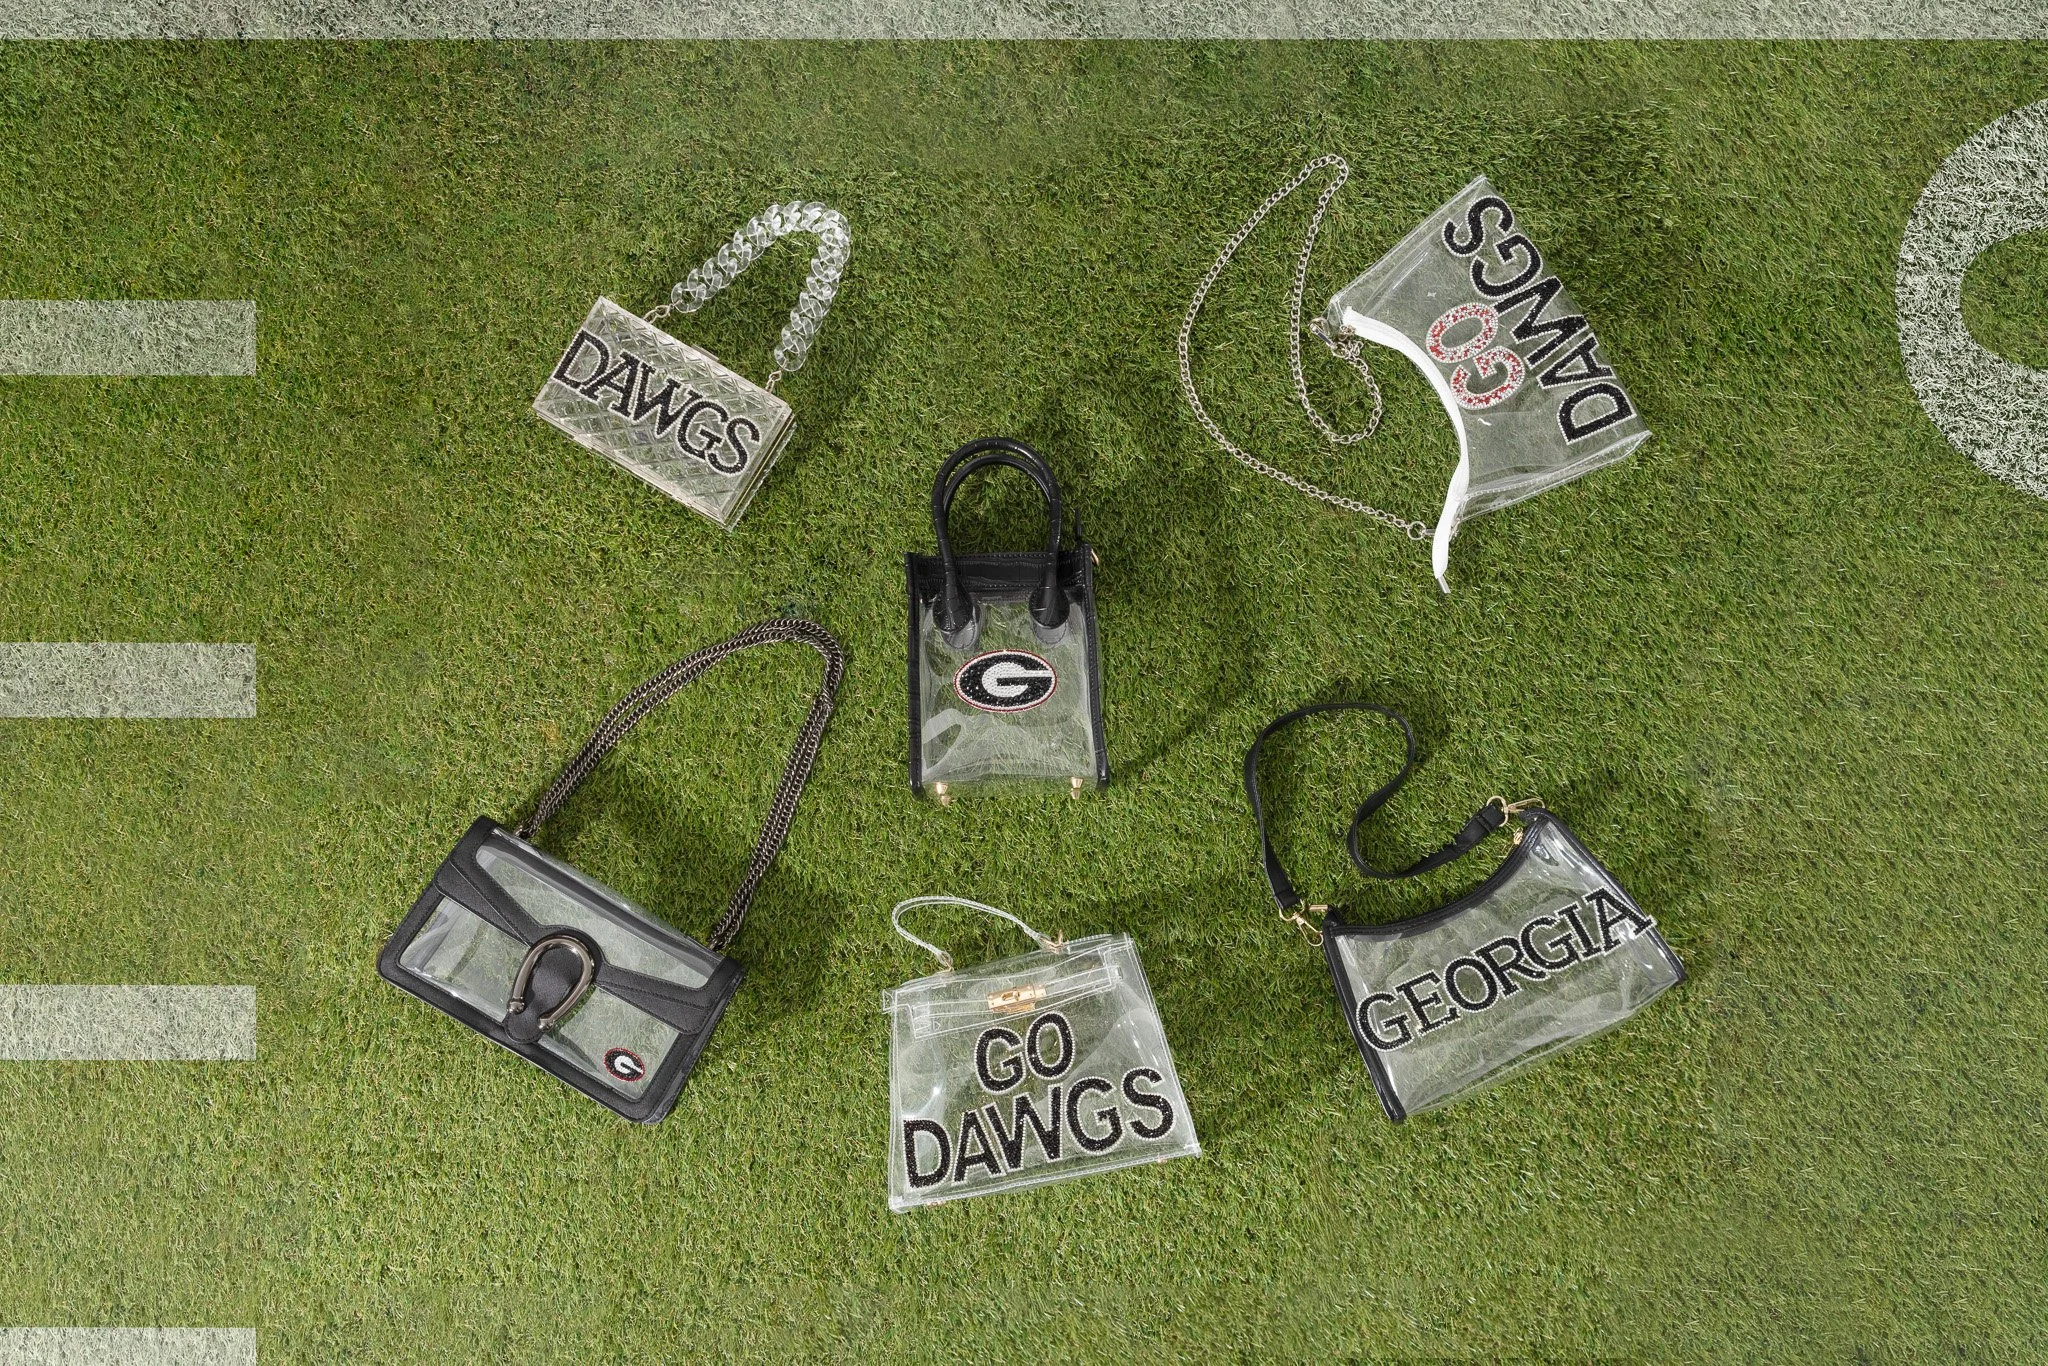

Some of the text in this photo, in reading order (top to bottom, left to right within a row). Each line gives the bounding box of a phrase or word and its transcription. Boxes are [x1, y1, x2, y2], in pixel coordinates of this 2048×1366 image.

[1425, 303, 1526, 409] GO
[1441, 195, 1637, 445] DAWGS
[551, 328, 760, 475] DAWGS
[1356, 886, 1657, 1052] GEORGIA
[974, 1011, 1075, 1094] GO
[902, 1066, 1175, 1191] DAWGS
